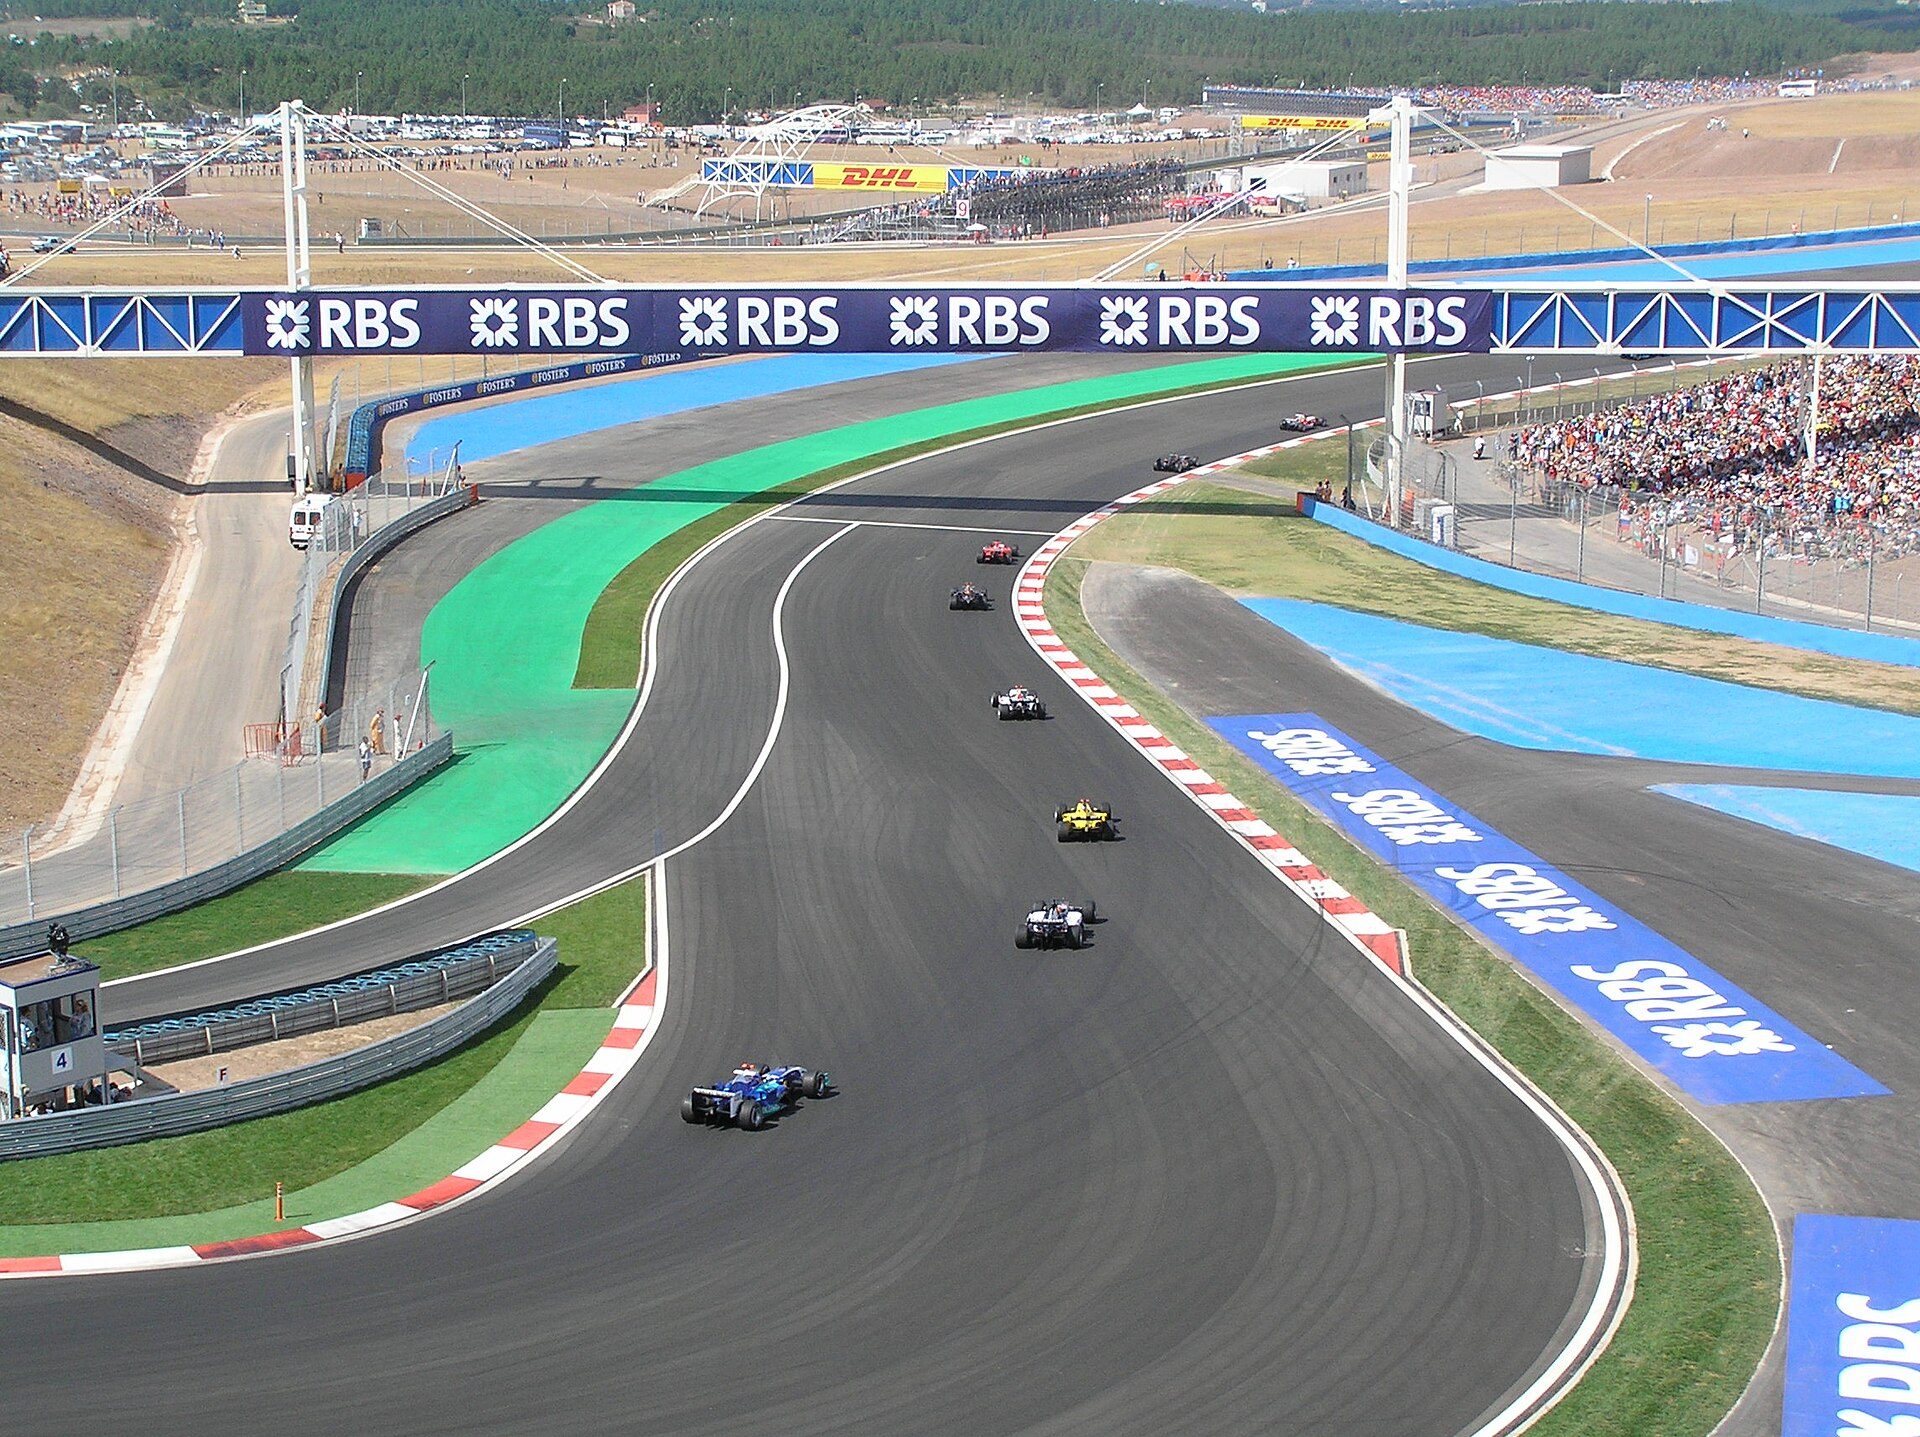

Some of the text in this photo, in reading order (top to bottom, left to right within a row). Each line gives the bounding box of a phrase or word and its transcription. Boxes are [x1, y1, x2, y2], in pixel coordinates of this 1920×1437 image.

[1267, 118, 1350, 128] DHL DHL
[841, 167, 918, 188] DHL
[958, 202, 967, 216] 9
[320, 299, 420, 349] RBS
[529, 297, 630, 347] RBS
[738, 296, 839, 346] RBS
[949, 296, 1050, 346] RBS
[1159, 296, 1260, 345] RBS
[1370, 297, 1467, 346] RBS
[591, 359, 626, 374] FOSTER'S
[648, 353, 681, 365] FOSTERS
[482, 376, 516, 393] FOSTER'S
[538, 367, 570, 383] FOSTER'S
[429, 387, 462, 404] FOSTER'S
[1248, 729, 1361, 761] RBS
[1332, 789, 1459, 826] RBS
[1435, 863, 1581, 910] RBS
[1570, 960, 1747, 1022] RBS
[56, 1052, 67, 1069] 4
[219, 1067, 228, 1081] F
